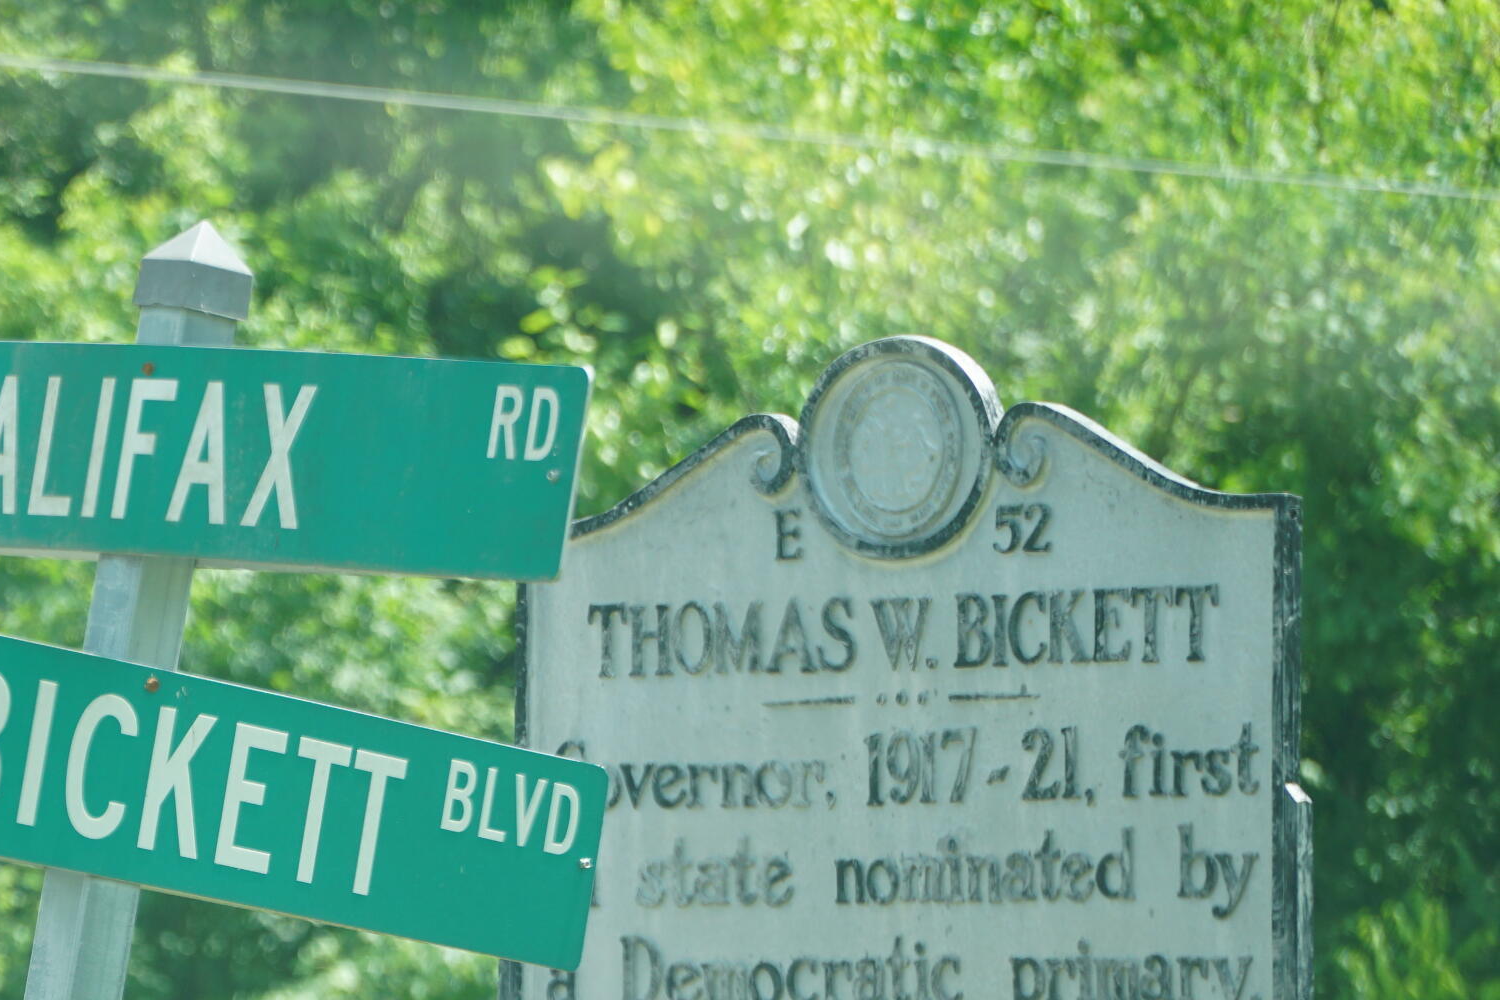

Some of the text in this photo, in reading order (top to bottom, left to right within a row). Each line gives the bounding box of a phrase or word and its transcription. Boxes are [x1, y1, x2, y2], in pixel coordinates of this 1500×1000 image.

[486, 384, 560, 462] RD
[773, 503, 1053, 562] E 52
[587, 583, 1219, 678] THOMAS W. BICKETT
[440, 758, 580, 857] BLVD
[556, 740, 835, 811] vernor,
[1119, 721, 1260, 800] first
[636, 836, 795, 909] state
[835, 826, 1136, 908] nominated
[1178, 824, 1260, 919] by
